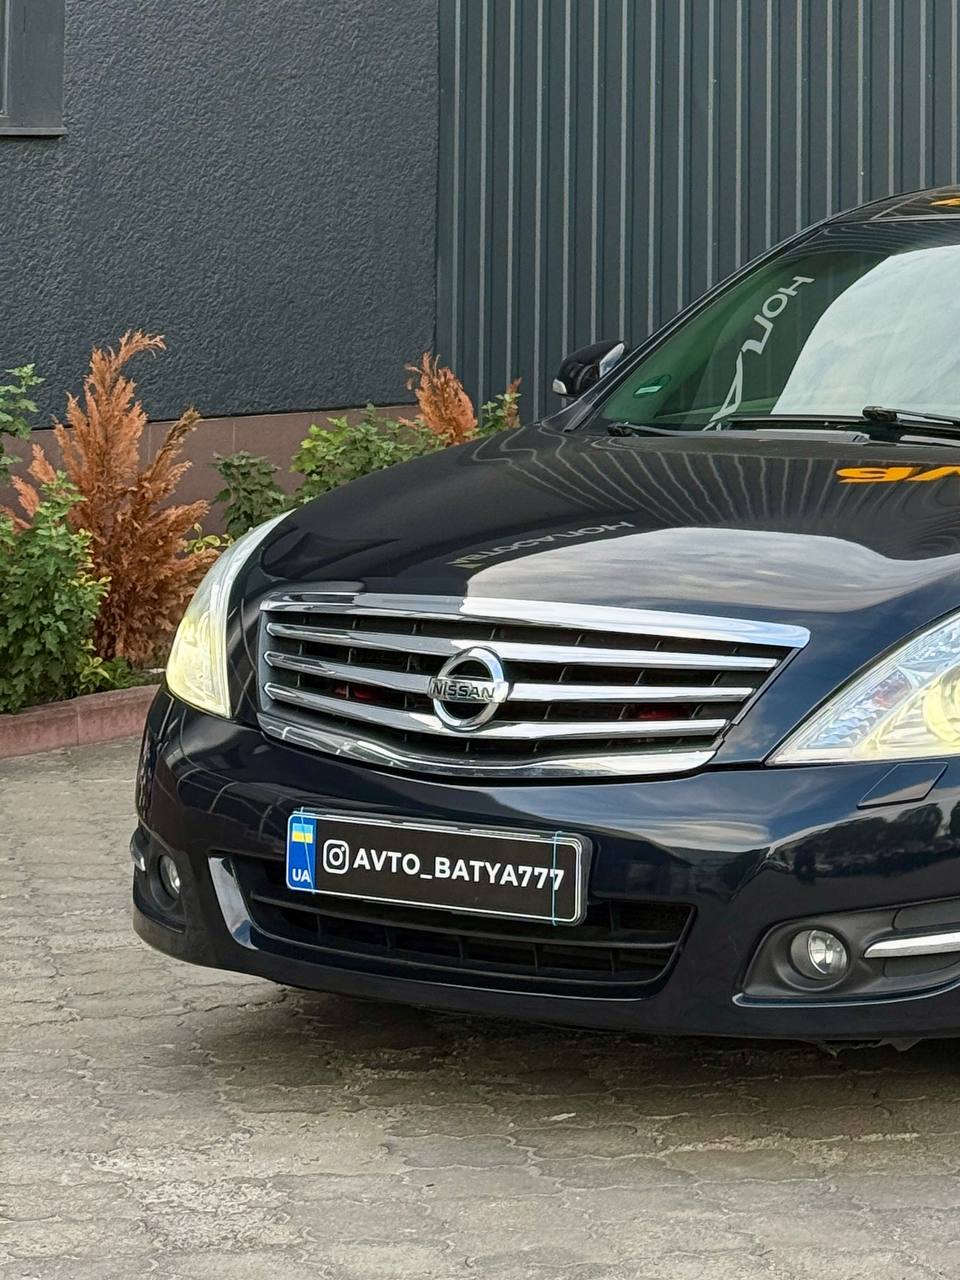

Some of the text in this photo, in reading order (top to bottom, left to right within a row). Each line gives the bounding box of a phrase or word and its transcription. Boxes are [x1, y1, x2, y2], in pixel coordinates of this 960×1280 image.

[432, 679, 495, 699] NISSAN
[292, 868, 312, 883] UA
[352, 847, 565, 890] AVTO_BATYA777
